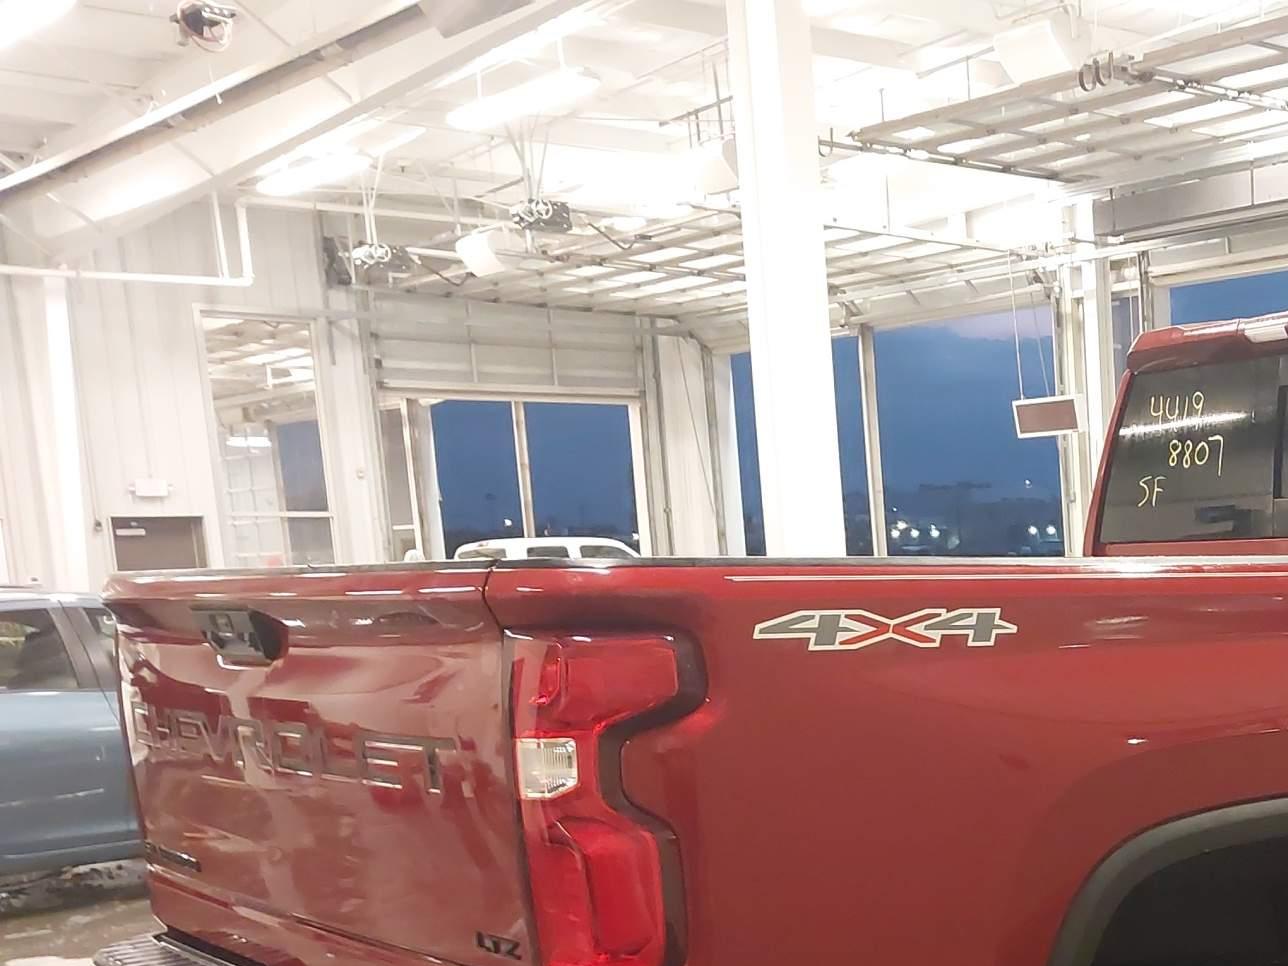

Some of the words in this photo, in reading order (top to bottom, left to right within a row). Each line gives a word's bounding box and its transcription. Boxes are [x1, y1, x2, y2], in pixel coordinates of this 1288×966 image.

[1150, 391, 1205, 432] 4419
[1168, 434, 1224, 477] 8807
[475, 930, 522, 961] LTZ
